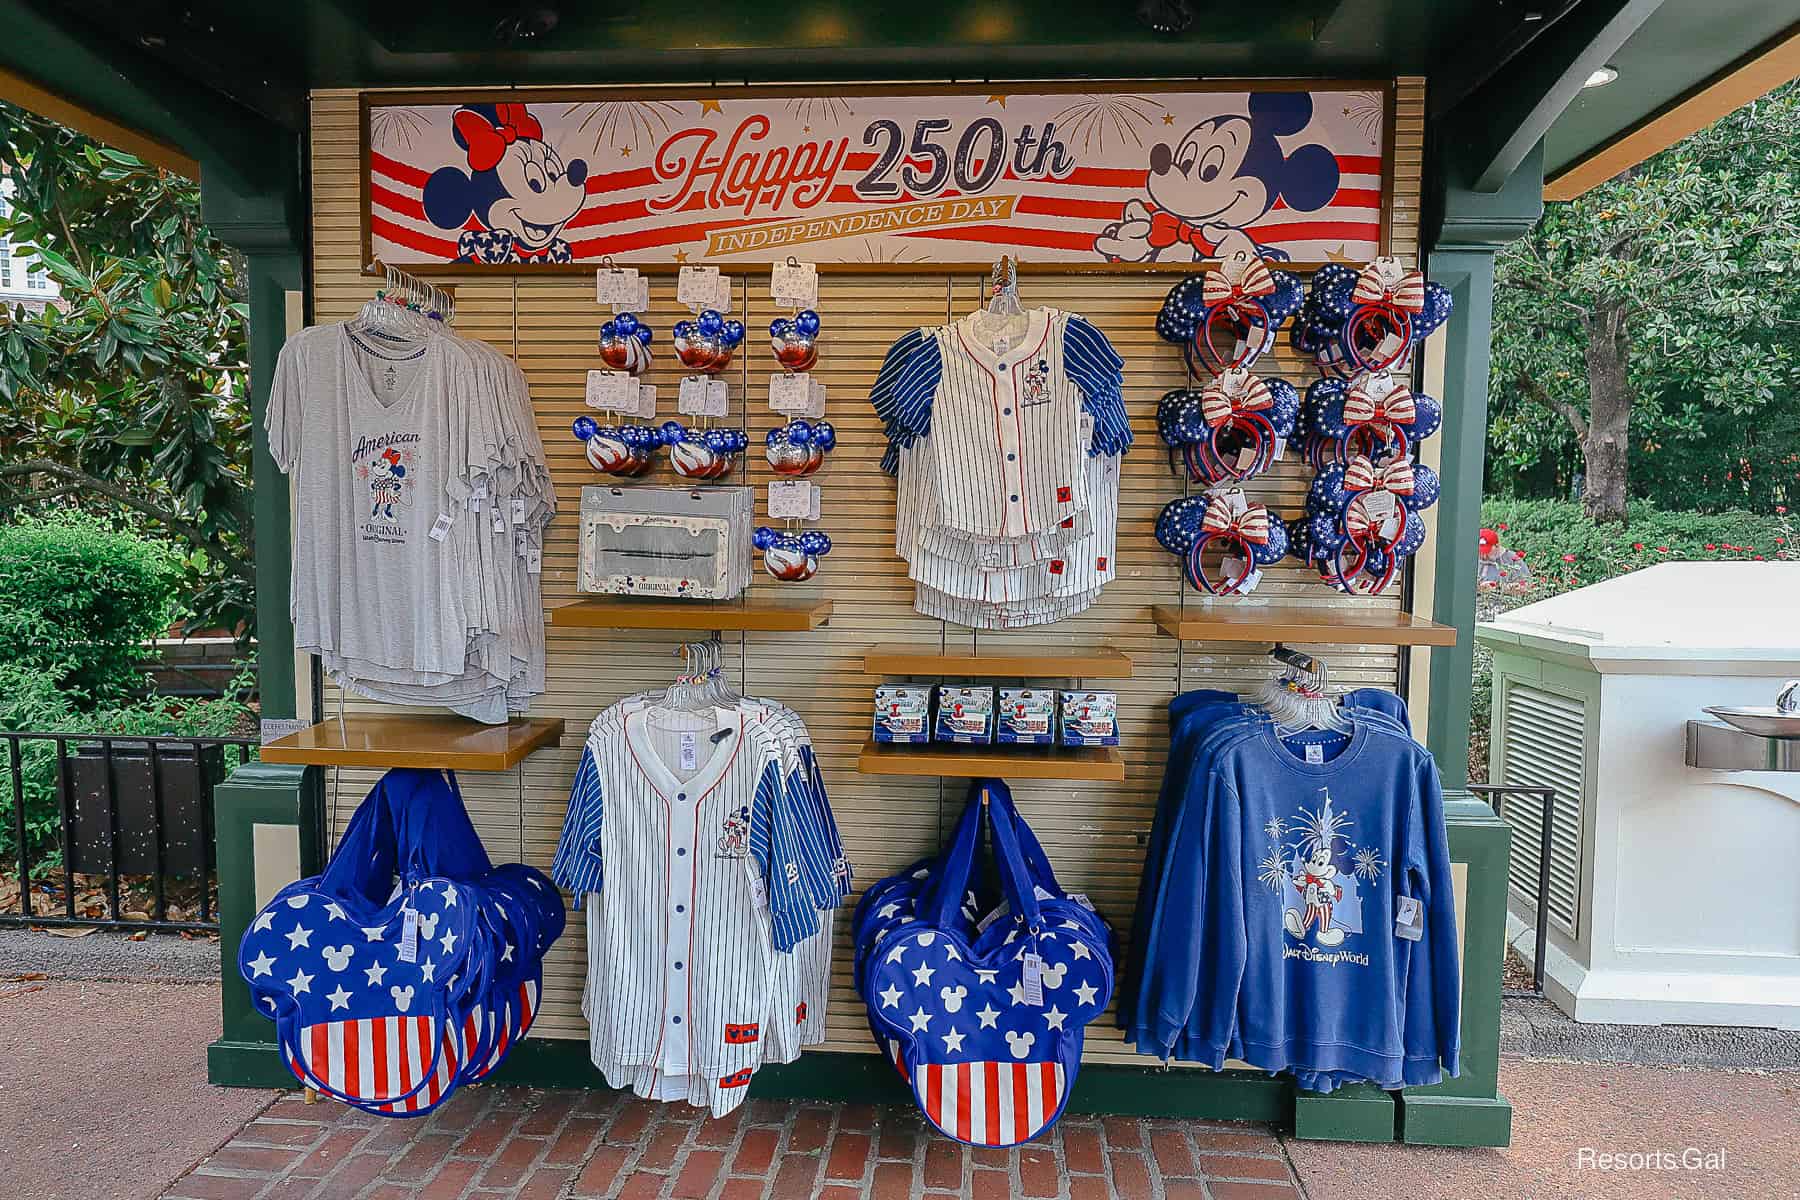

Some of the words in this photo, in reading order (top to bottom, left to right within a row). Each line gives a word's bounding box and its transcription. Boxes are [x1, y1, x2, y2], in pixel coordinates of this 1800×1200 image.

[649, 114, 850, 216] Happy
[855, 117, 1075, 197] 250th
[715, 204, 944, 251] INDEPENDENCE
[950, 199, 1008, 220] DAY
[352, 431, 421, 463] American
[1339, 950, 1369, 967] World
